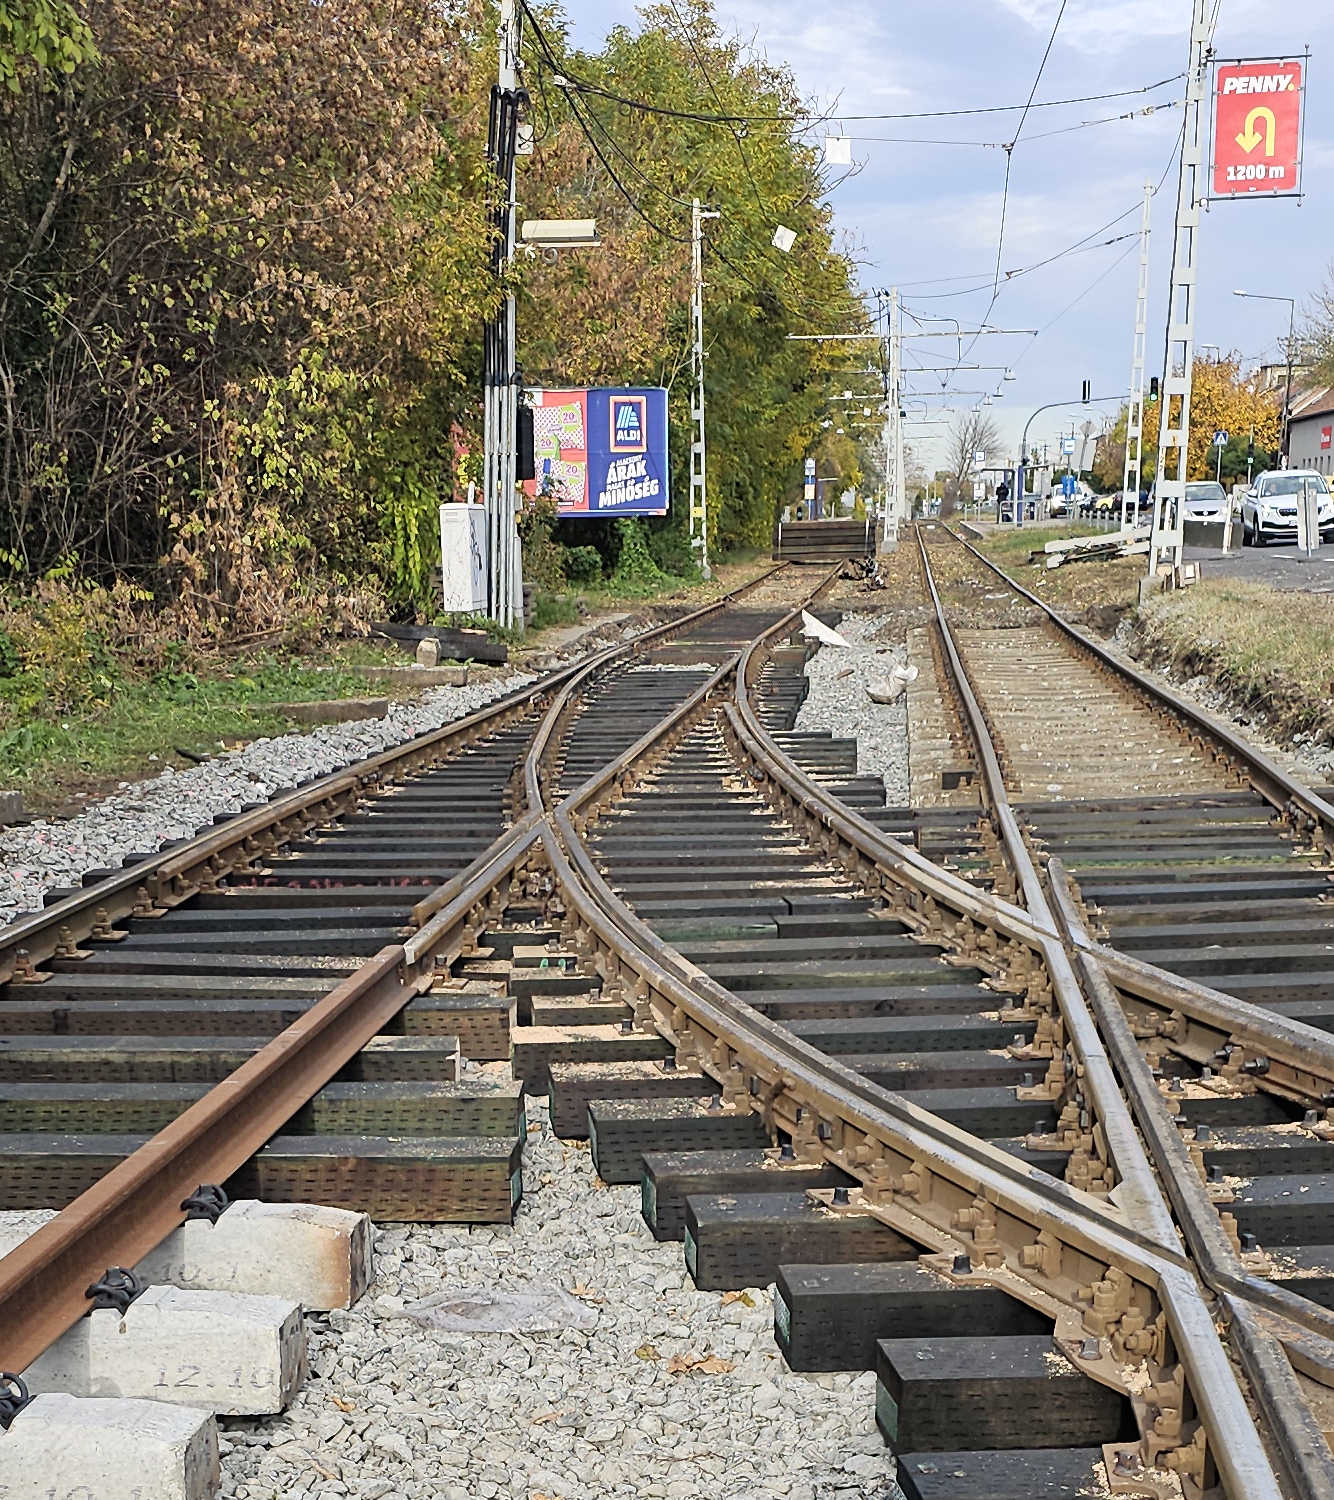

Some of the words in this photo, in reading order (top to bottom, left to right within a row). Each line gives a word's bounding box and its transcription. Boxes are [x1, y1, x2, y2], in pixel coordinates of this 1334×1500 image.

[1227, 165, 1266, 181] 1200
[1269, 166, 1285, 179] m
[617, 429, 641, 441] ALDI
[607, 460, 647, 484] ÁRAK
[598, 475, 659, 509] MINŐSÉG
